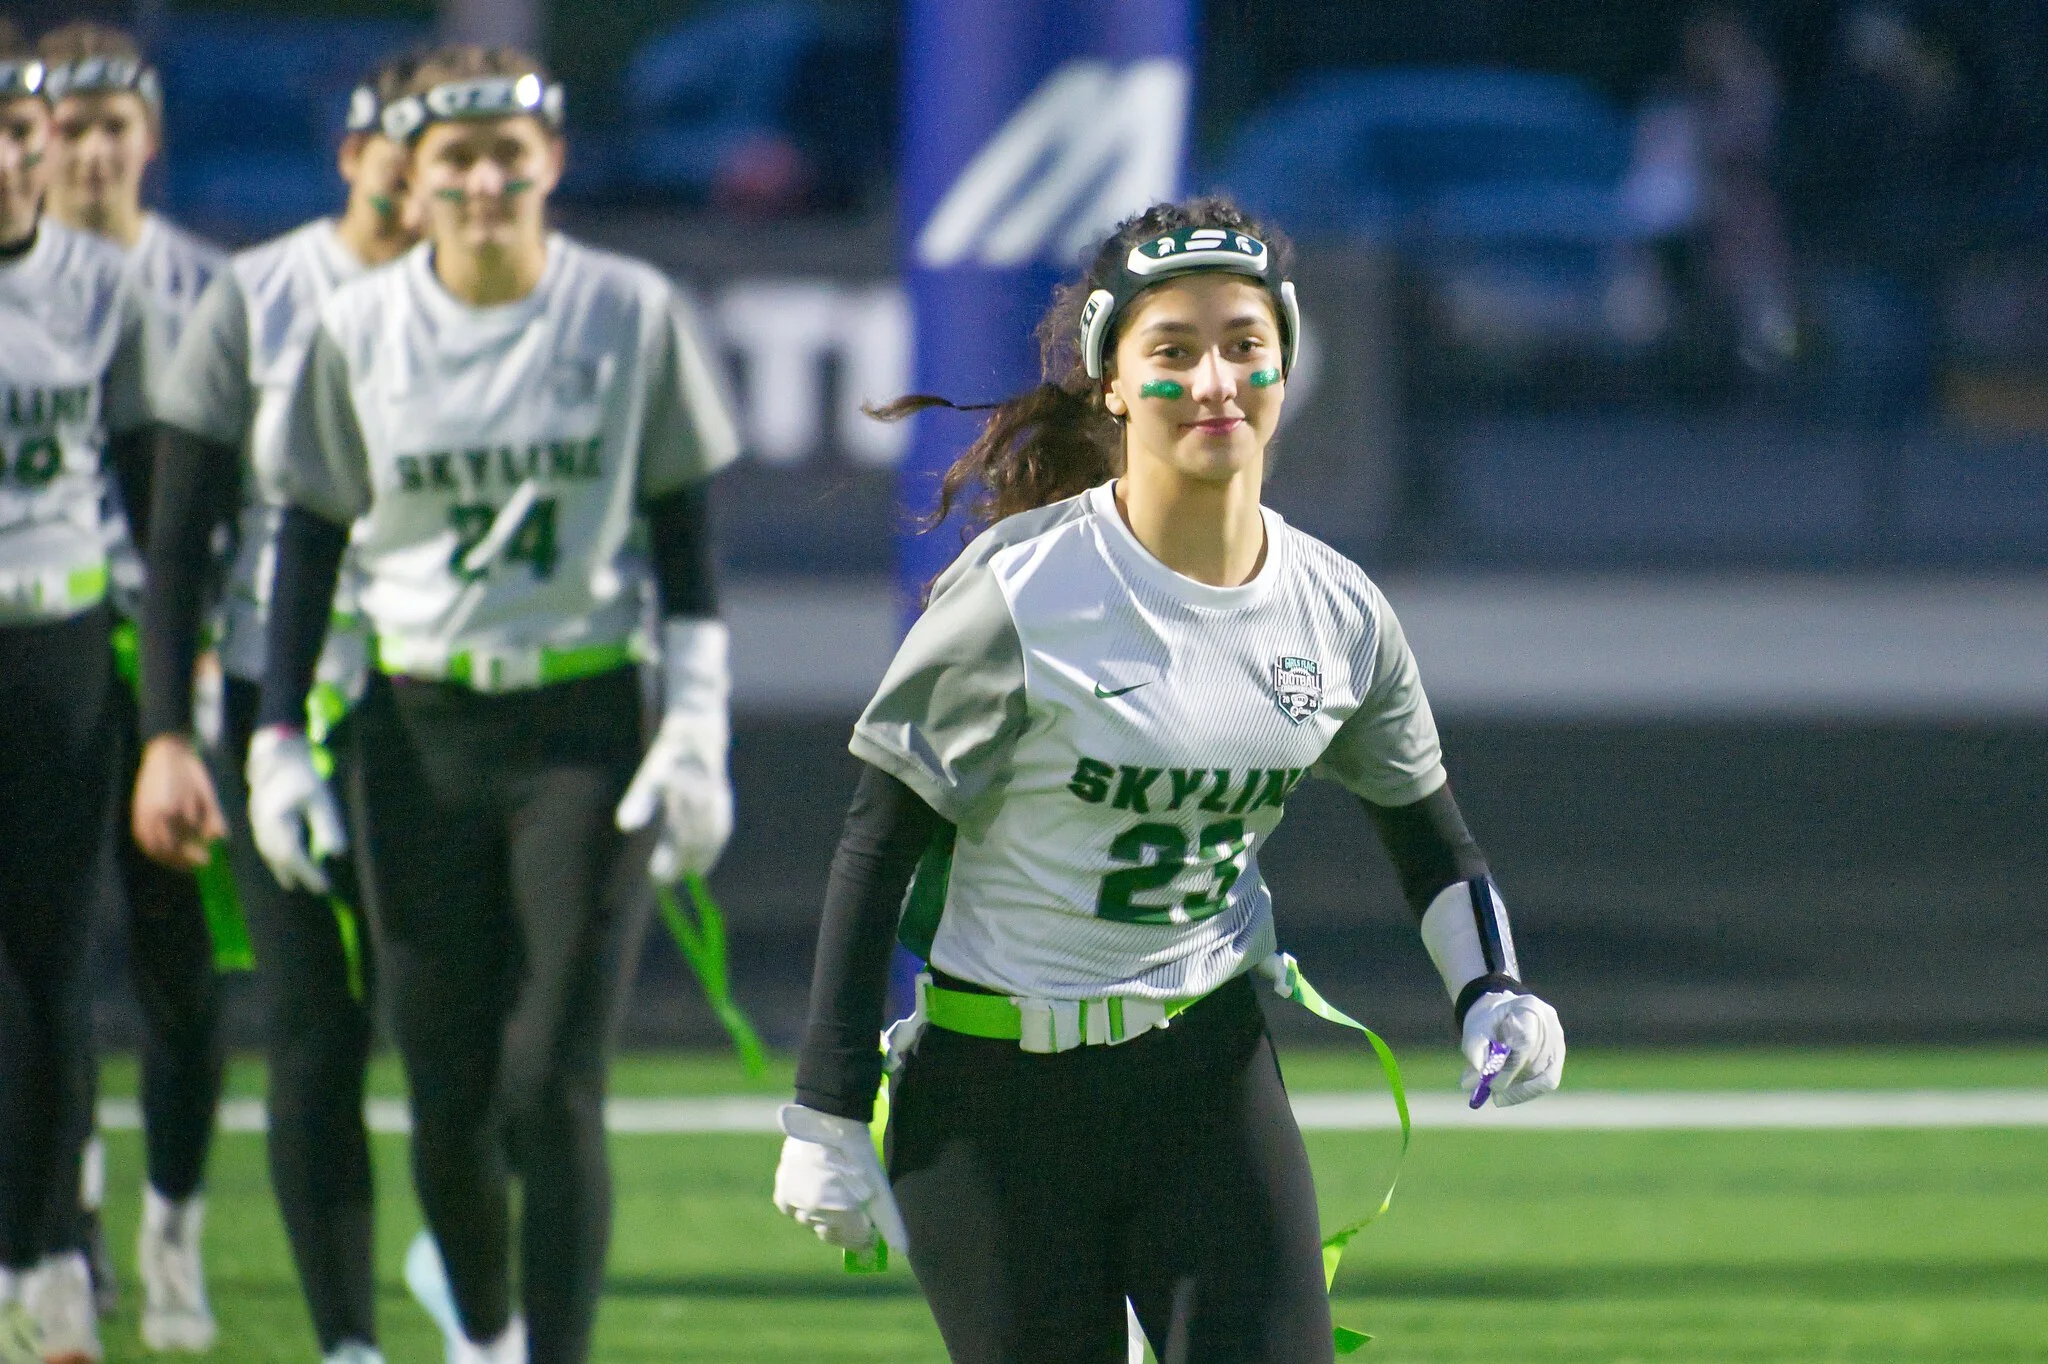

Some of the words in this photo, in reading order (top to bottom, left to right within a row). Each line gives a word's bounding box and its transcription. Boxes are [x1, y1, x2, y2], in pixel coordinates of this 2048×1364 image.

[447, 497, 558, 582] 24
[1277, 668, 1322, 692] FOOTBALL
[1301, 660, 1316, 674] FLAG
[1067, 757, 1305, 813] SKYLIN
[1096, 818, 1250, 925] 23
